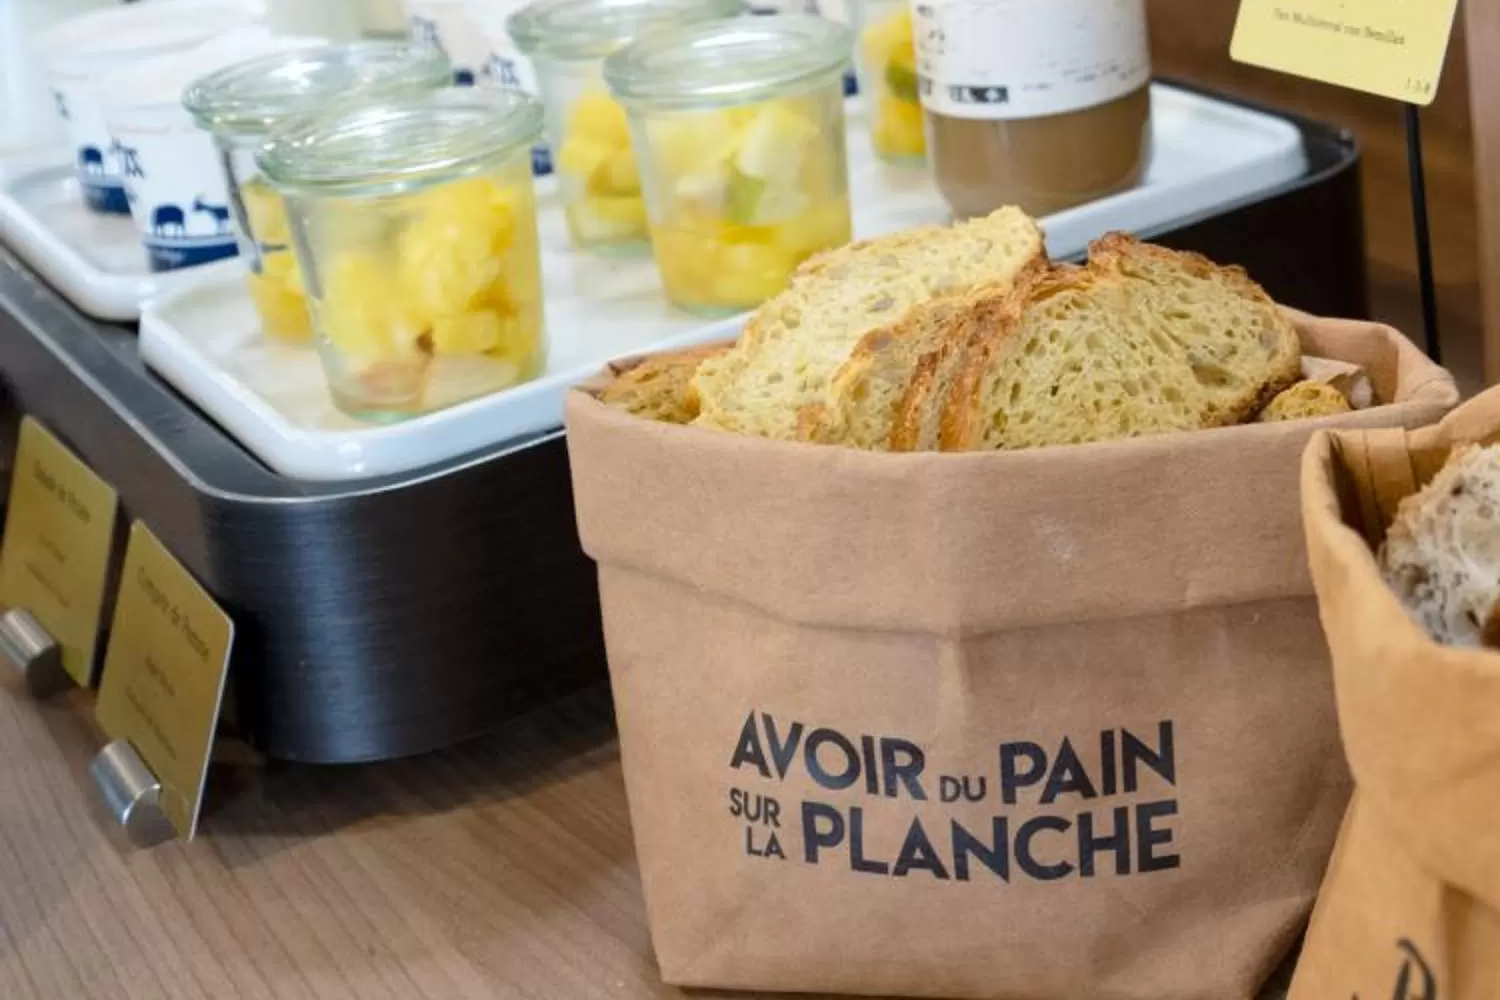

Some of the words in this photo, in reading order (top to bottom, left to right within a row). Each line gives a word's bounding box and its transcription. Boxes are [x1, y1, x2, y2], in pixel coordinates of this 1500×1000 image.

[729, 708, 928, 801] AVOIR
[939, 775, 987, 803] DU
[1000, 719, 1177, 806] PAIN
[729, 787, 781, 828] SUR
[800, 798, 1181, 883] PLANCHE
[745, 826, 787, 861] LA
